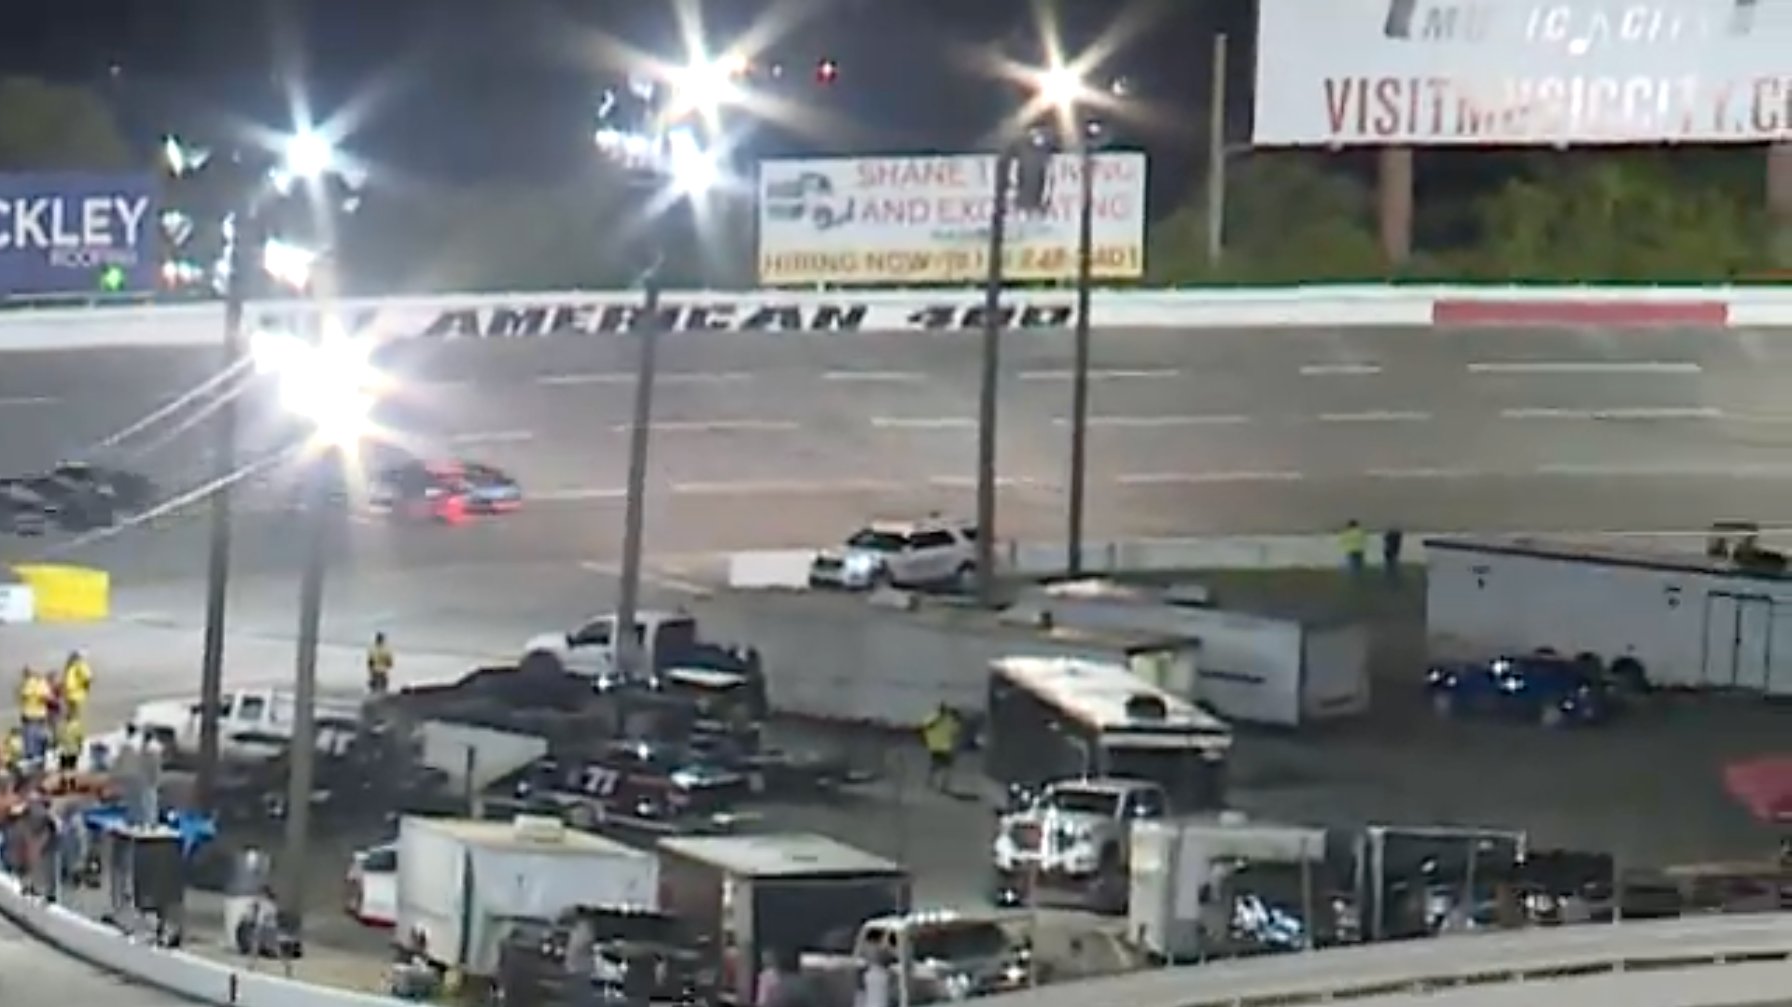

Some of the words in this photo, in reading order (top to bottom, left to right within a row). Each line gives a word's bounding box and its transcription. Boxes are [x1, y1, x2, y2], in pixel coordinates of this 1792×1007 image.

[862, 199, 930, 223] AND
[422, 303, 868, 336] AMERICAN
[909, 306, 1072, 330] 400
